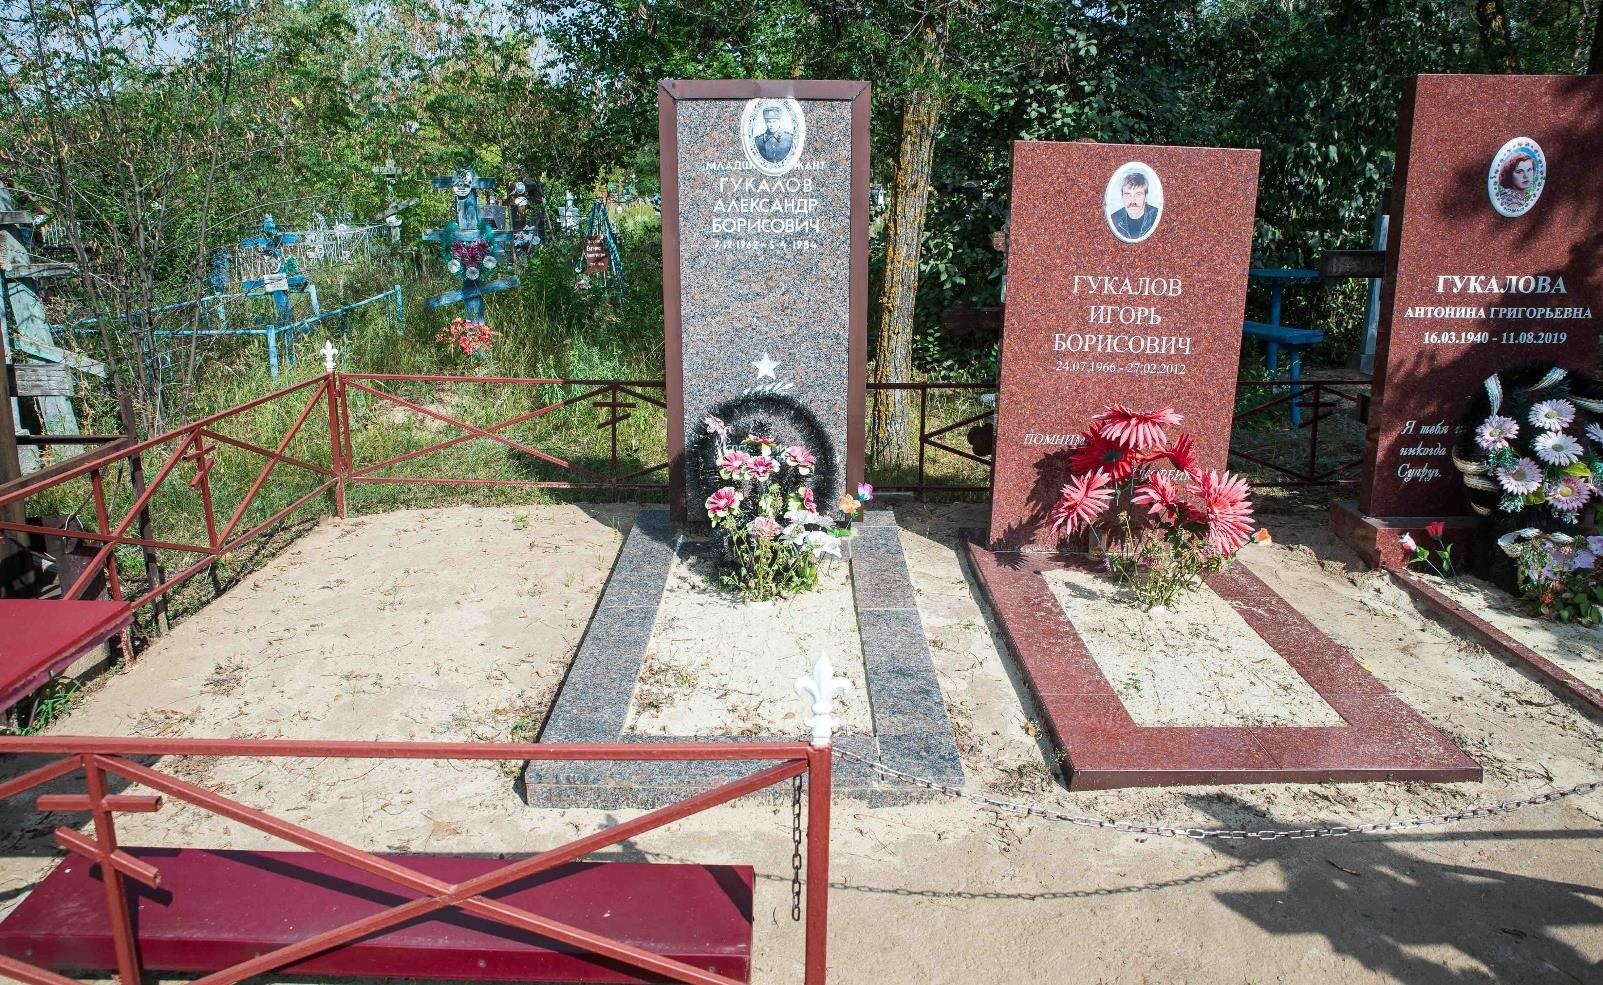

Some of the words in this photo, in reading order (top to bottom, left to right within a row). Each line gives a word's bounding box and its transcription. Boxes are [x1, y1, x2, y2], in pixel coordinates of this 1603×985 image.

[706, 161, 755, 170] МЛАДШ
[720, 177, 813, 193] ГУКАЛОВ
[713, 198, 819, 214] АЛЕКСАНДР
[712, 218, 820, 233] БОРИСОВИЧ
[1072, 275, 1183, 297] ГУКАЛОВ
[1435, 275, 1568, 295] ГУКАЛОВА
[1087, 305, 1162, 326] ИГОРЬ
[1403, 306, 1486, 319] АНТОНИНА
[1489, 307, 1593, 320] ГРИГОРЬЕВНА
[1053, 332, 1192, 355] БОРИСОВИЧ
[1423, 331, 1489, 344] 16.03.1940
[1500, 331, 1568, 345] 11.08.2019
[1055, 360, 1116, 373] 24.07.1966
[1126, 362, 1187, 375] 27.02.2012
[1401, 420, 1417, 435] Я
[1420, 420, 1450, 435] тебя
[1399, 441, 1447, 456] никогда
[1397, 462, 1442, 483] Супруг.
